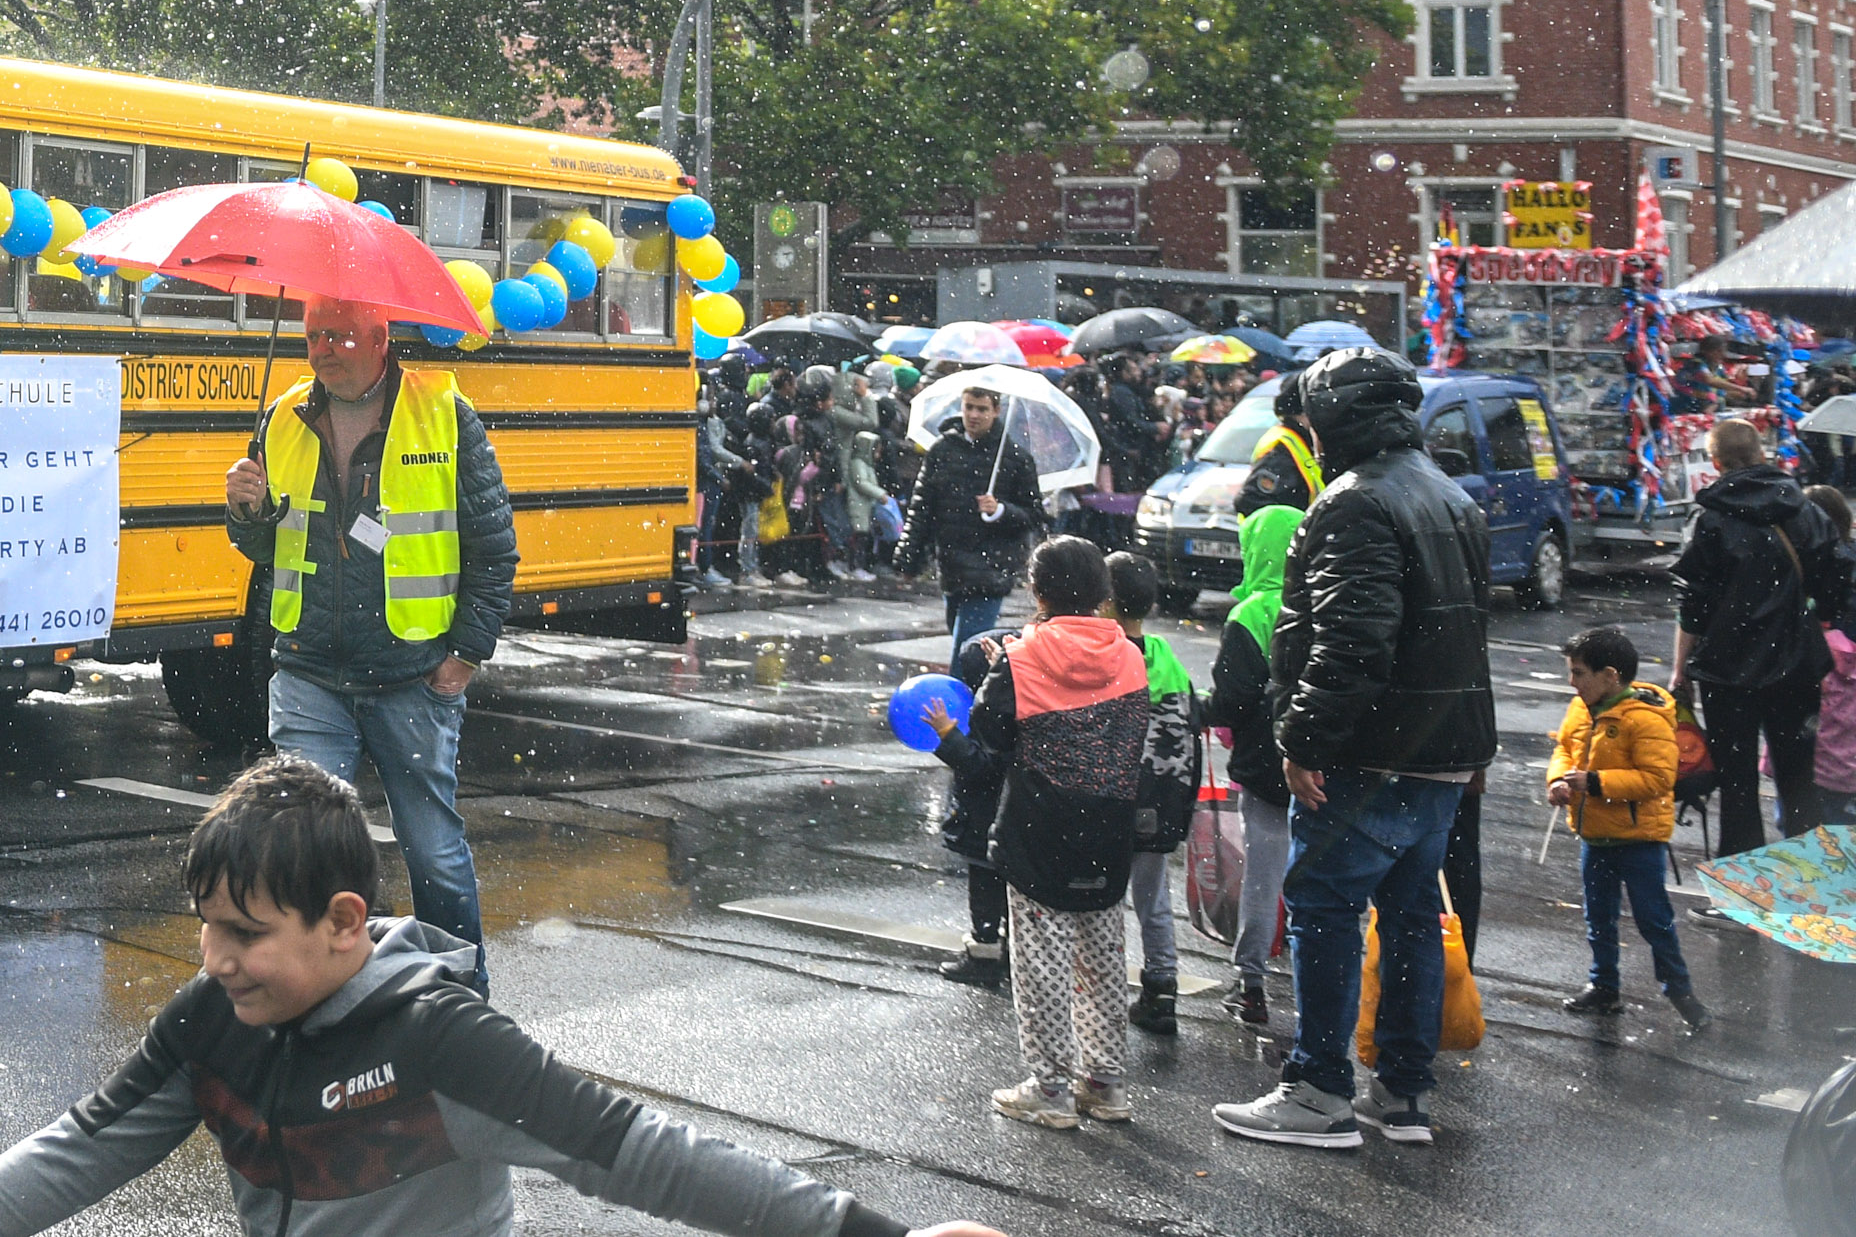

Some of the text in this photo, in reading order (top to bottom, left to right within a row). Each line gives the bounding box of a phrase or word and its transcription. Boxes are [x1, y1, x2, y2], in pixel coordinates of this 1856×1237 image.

[1513, 187, 1586, 208] HALLO
[121, 362, 259, 401] DISTRICT SCHOOL
[25, 450, 94, 468] GEHT
[401, 451, 450, 466] ORDNER
[1, 495, 44, 514] DIE
[57, 536, 87, 555] AB
[41, 607, 106, 630] 26010
[347, 1061, 396, 1096] BRKLN
